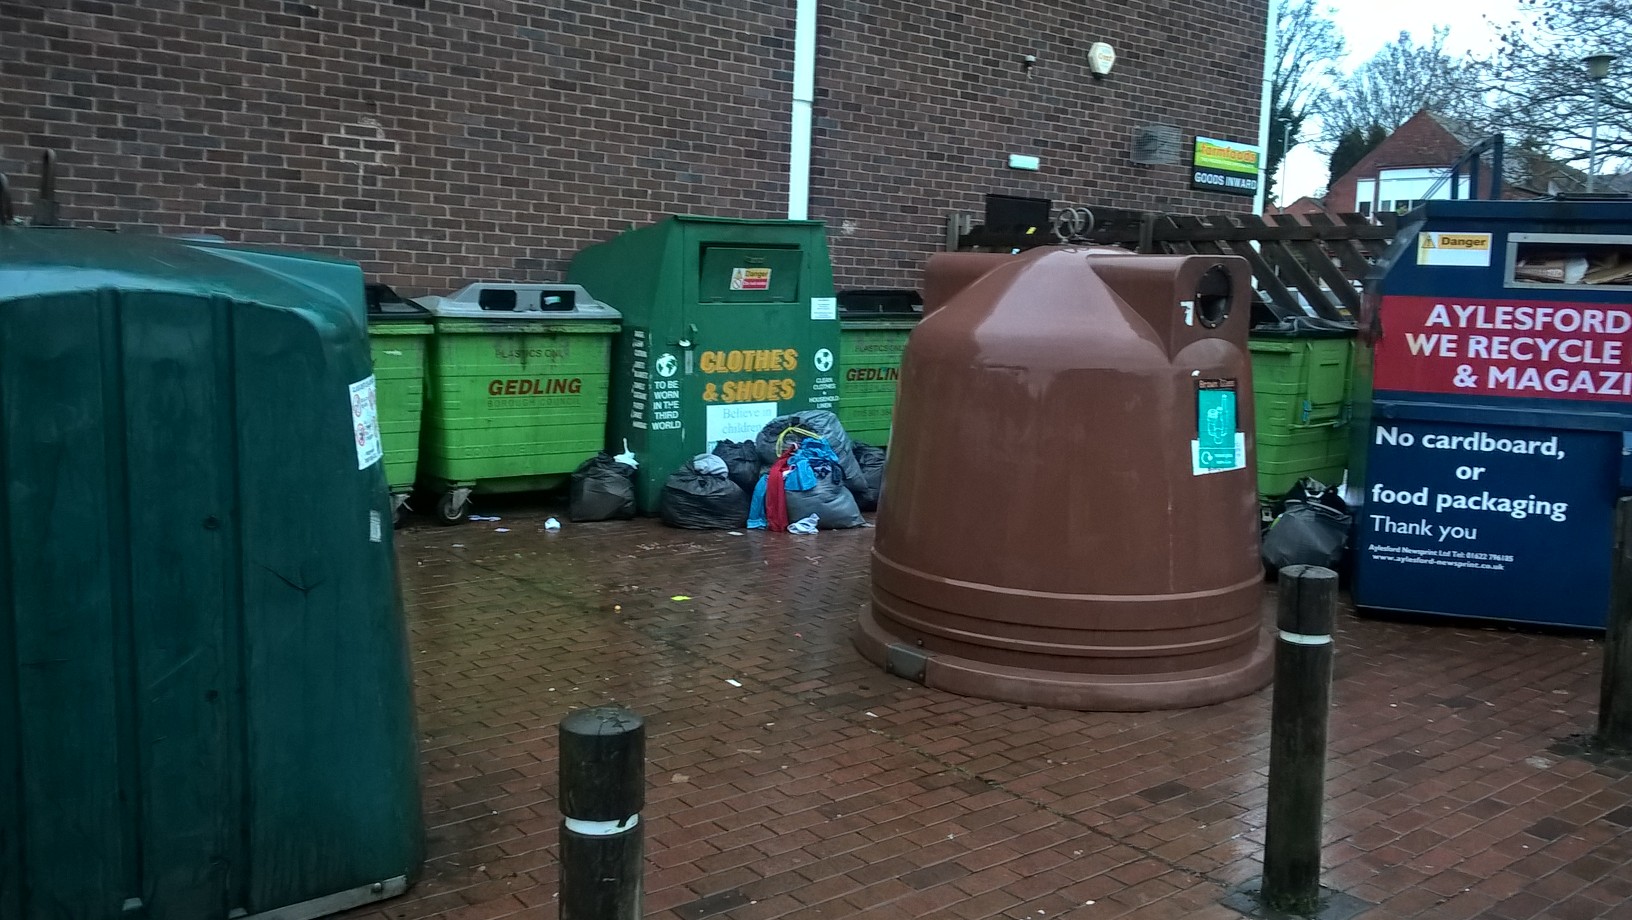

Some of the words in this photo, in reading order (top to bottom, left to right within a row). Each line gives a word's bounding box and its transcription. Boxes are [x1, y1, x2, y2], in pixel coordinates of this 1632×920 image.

[1194, 172, 1225, 186] GOODS
[1225, 176, 1257, 190] INWARD
[1441, 236, 1487, 248] Danger
[1424, 304, 1631, 334] AYLESFORD
[1405, 332, 1458, 357] WE
[1467, 335, 1623, 365] RECYCLE
[700, 348, 798, 374] CLOTHES
[846, 367, 900, 381] GEDLIN
[1453, 364, 1479, 388] &
[488, 378, 582, 396] GEDLING
[654, 381, 667, 390] TO
[667, 380, 680, 389] BE
[703, 382, 719, 402] &
[721, 378, 796, 403] SHOES
[654, 390, 680, 400] WORN
[808, 395, 840, 403] HOUSEHOLD
[653, 402, 663, 410] IN
[663, 400, 680, 409] THE
[722, 408, 760, 419] Believe
[654, 411, 679, 420] THIRD
[651, 420, 682, 431] WORLD
[1375, 426, 1415, 447] No
[1421, 431, 1566, 460] cardboard,
[1455, 465, 1487, 481] or
[1371, 483, 1429, 506] food
[1435, 491, 1569, 522] packaging
[1369, 514, 1434, 537] Thank
[1438, 524, 1478, 543] you
[1368, 543, 1400, 553] Aylesford
[1401, 547, 1437, 557] Newsprint
[1466, 552, 1488, 560] 01622
[1371, 554, 1505, 571] www.aylesford-newsprint.co.uk
